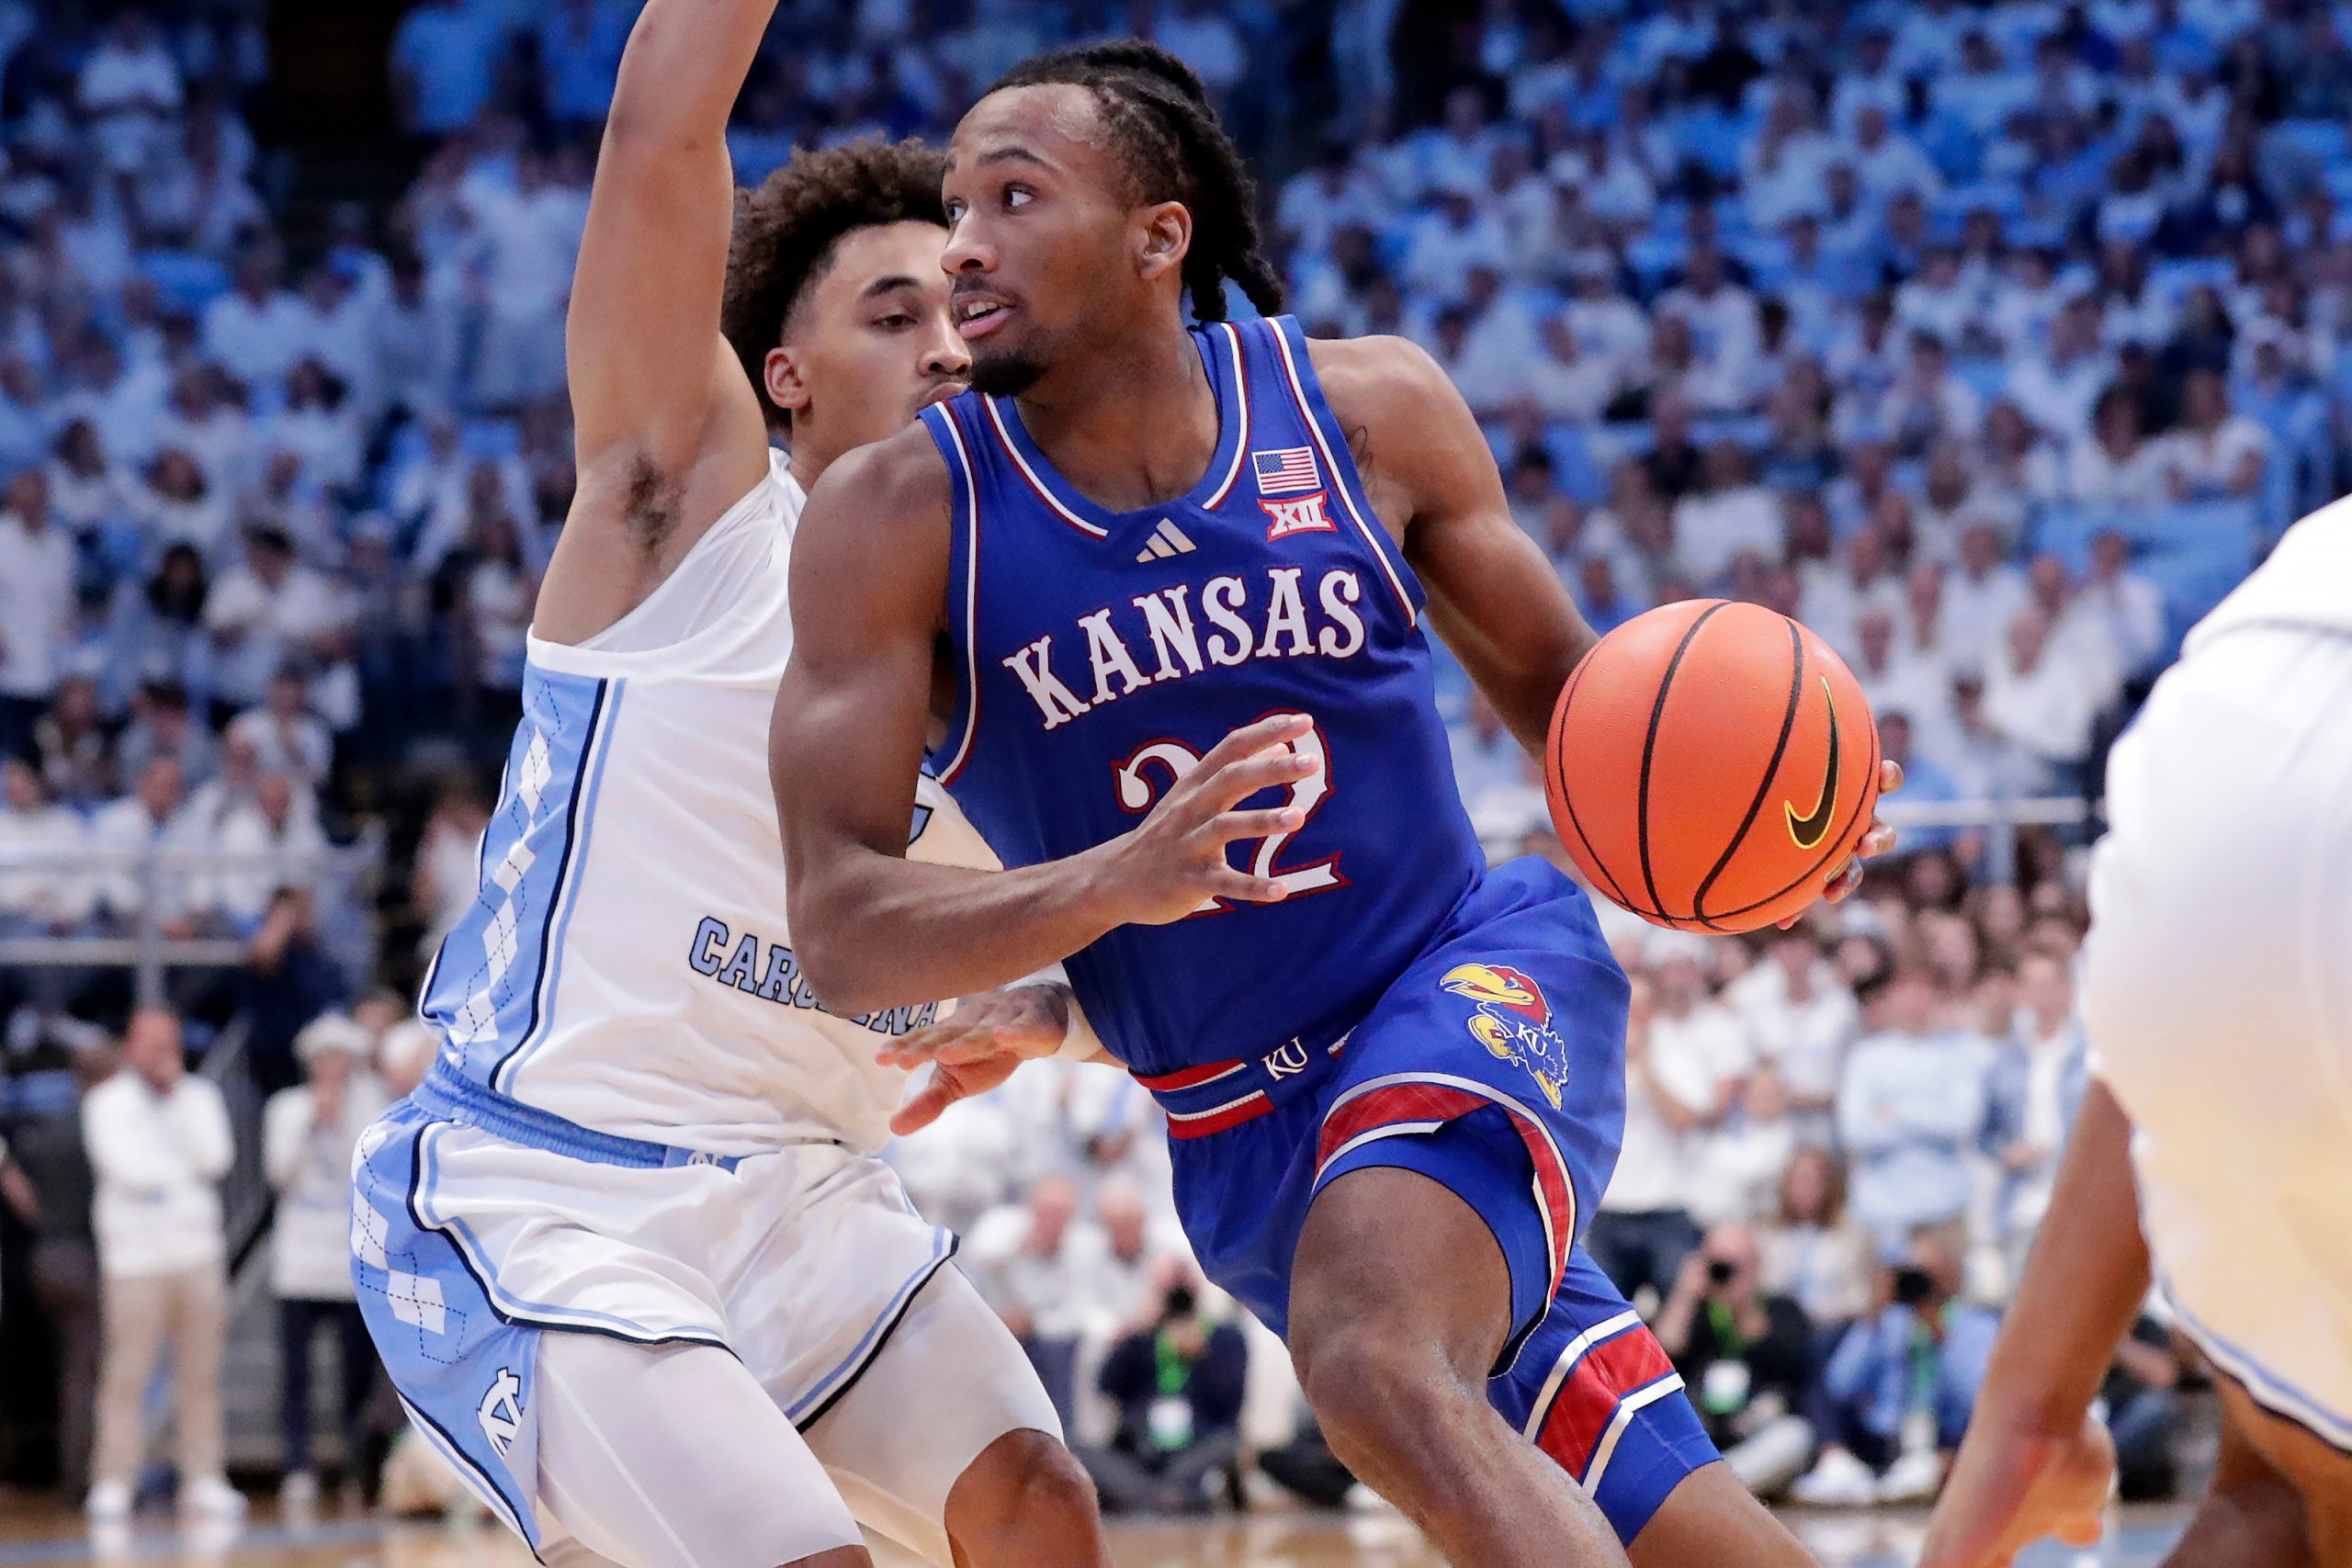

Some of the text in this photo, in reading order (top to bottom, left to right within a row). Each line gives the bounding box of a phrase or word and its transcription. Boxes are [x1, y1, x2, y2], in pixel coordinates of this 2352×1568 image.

[1262, 495, 1332, 537] XII
[1001, 567, 1367, 731] KANSAS
[689, 916, 939, 1036] CARNA
[1261, 1035, 1308, 1082] KU
[1517, 1021, 1548, 1056] KU
